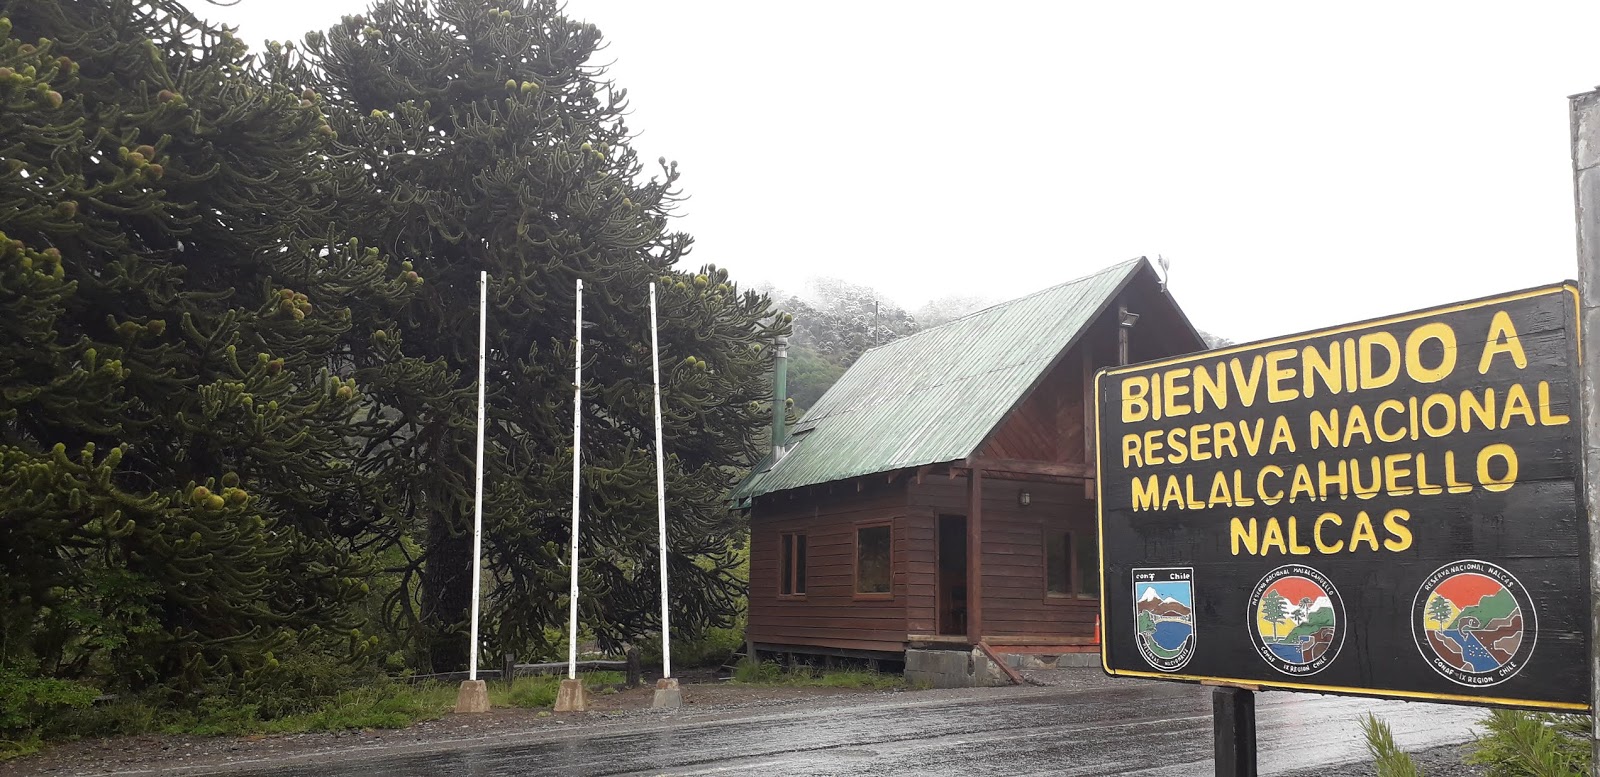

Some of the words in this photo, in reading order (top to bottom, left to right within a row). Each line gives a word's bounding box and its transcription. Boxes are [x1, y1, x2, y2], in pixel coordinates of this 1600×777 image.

[1121, 322, 1457, 424] BIENVENIDO
[1478, 310, 1528, 375] A
[1122, 415, 1296, 468] RESERVA
[1309, 381, 1570, 449] NACIONAL
[1131, 443, 1518, 512] MALALCAHUELLO
[1230, 508, 1413, 556] NALCAS
[1425, 569, 1450, 591] RESERVA
[1450, 563, 1484, 573] NACIONAL
[1488, 567, 1514, 588] NALCAS
[1433, 657, 1454, 675] CONAF
[1467, 675, 1494, 684] REGION
[1499, 661, 1517, 677] CHILE
